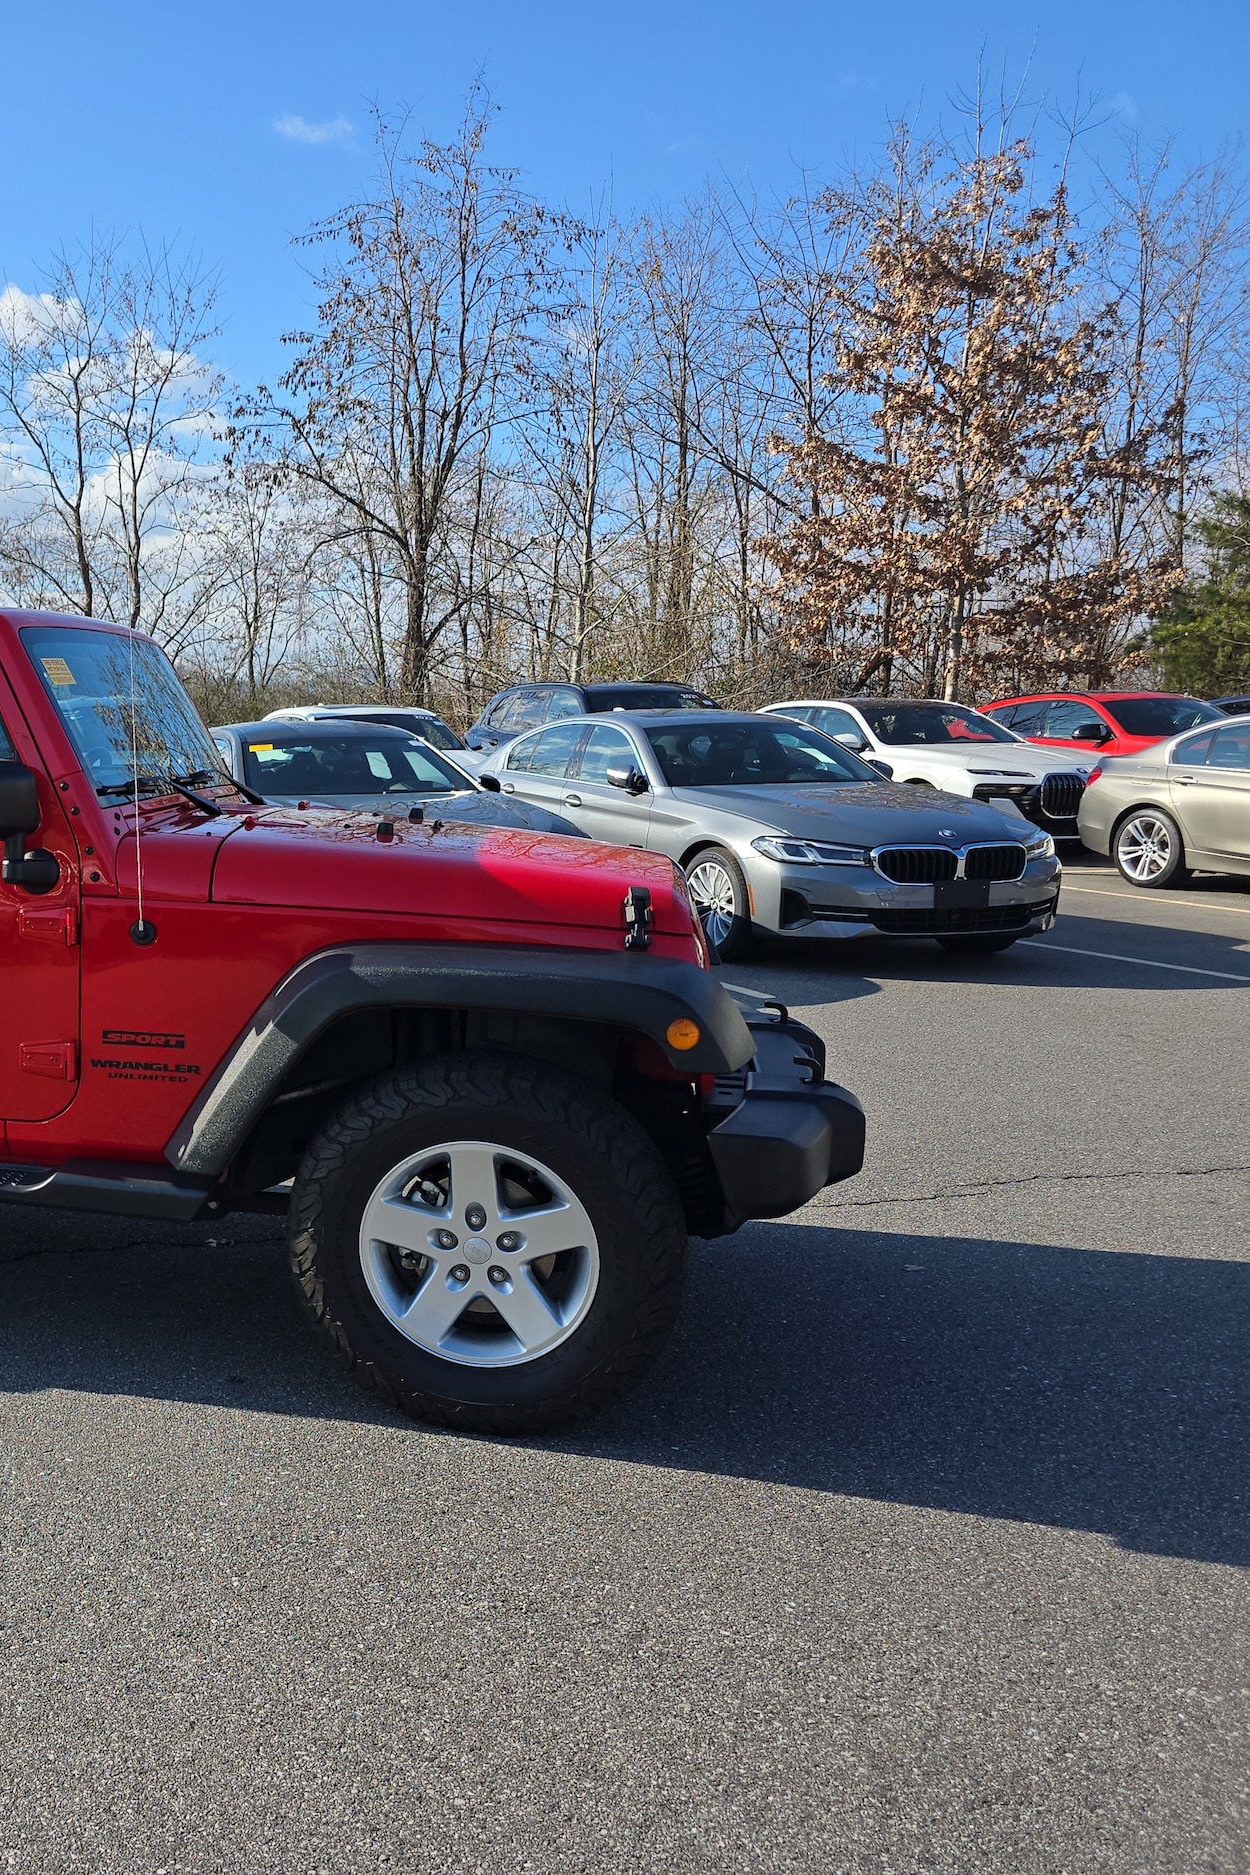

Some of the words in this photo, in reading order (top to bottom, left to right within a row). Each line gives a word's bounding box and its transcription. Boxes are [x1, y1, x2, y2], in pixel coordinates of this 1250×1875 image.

[102, 1031, 184, 1047] SPORT
[90, 1059, 201, 1075] WRANGLER
[108, 1072, 188, 1083] UNLIMITED
